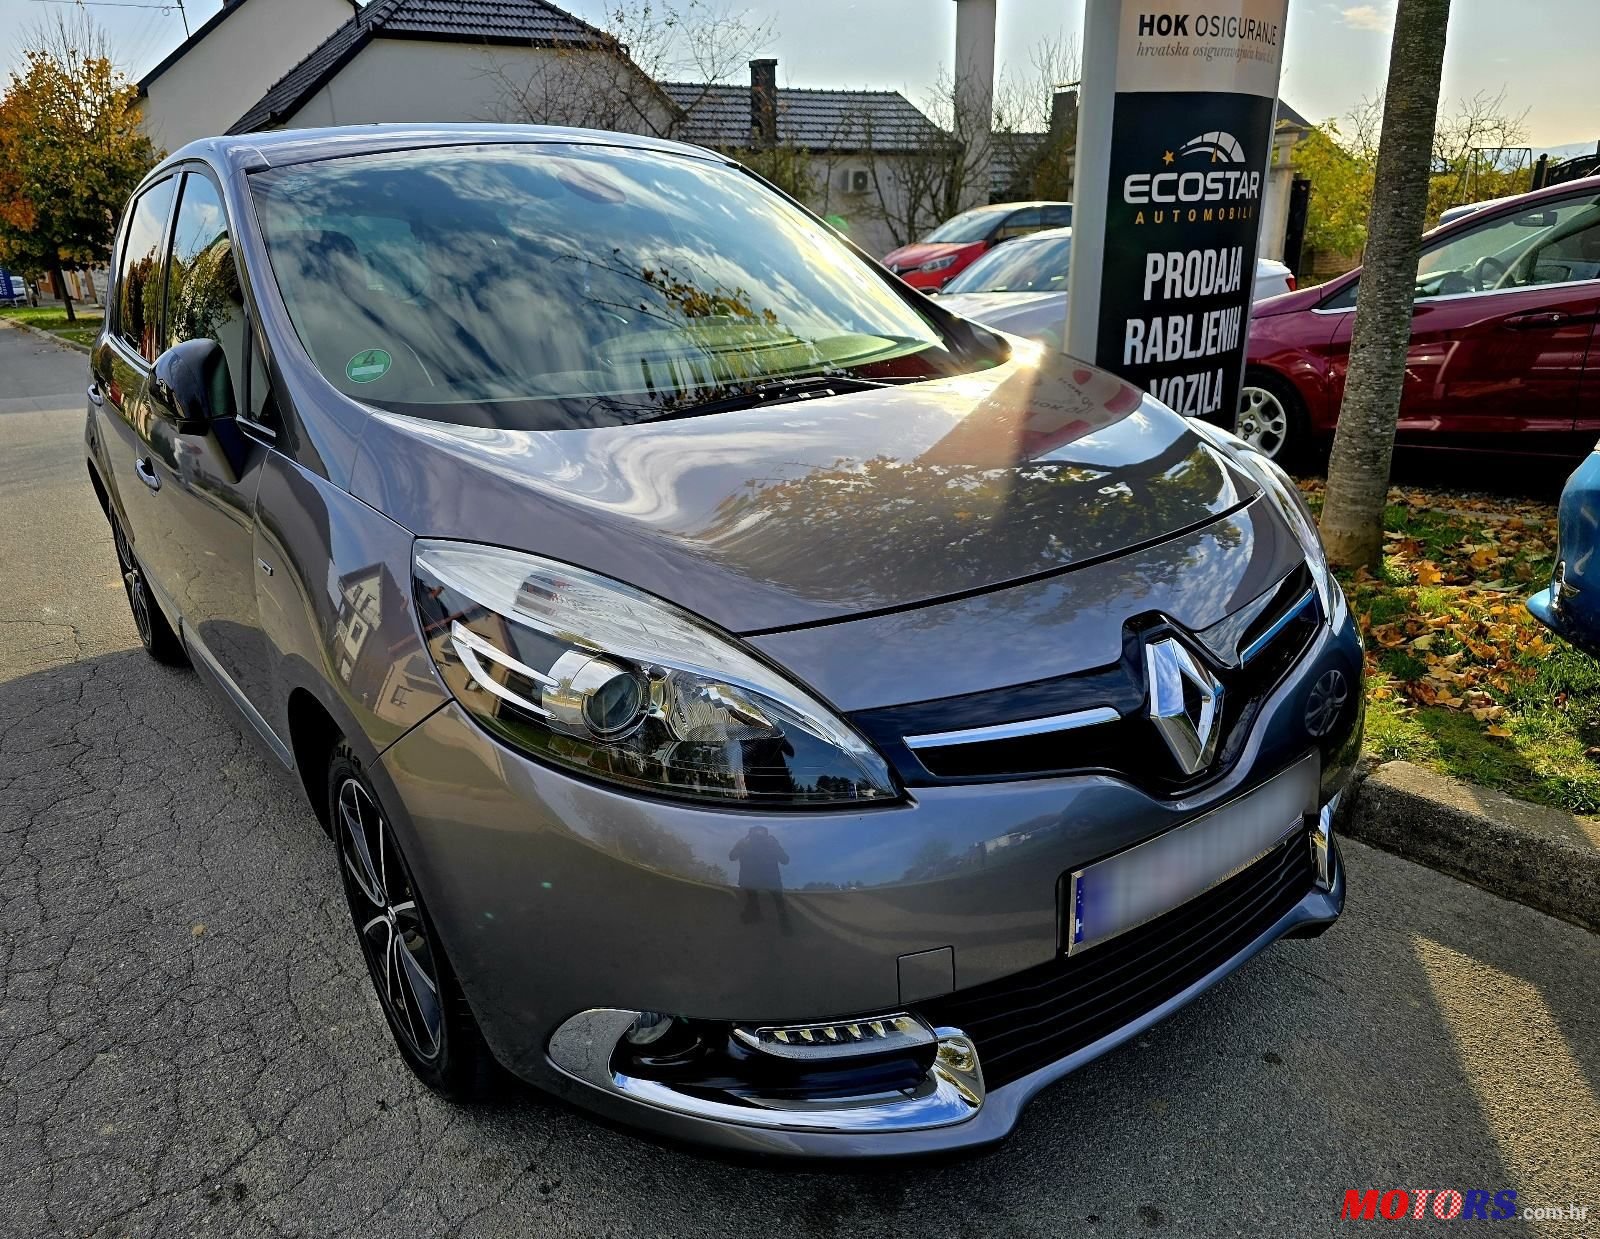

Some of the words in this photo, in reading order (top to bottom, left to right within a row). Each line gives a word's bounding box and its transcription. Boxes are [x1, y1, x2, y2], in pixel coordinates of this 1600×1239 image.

[1138, 14, 1189, 37] HOK
[1195, 15, 1278, 46] OSIGURANJE
[1136, 41, 1189, 57] hrvatska
[1123, 171, 1260, 204] ECOSTAR
[1135, 206, 1252, 225] AUTOMOBILI
[1143, 246, 1243, 301] PRODAJA
[1123, 305, 1242, 365] RABLJENIH
[362, 351, 376, 366] 4
